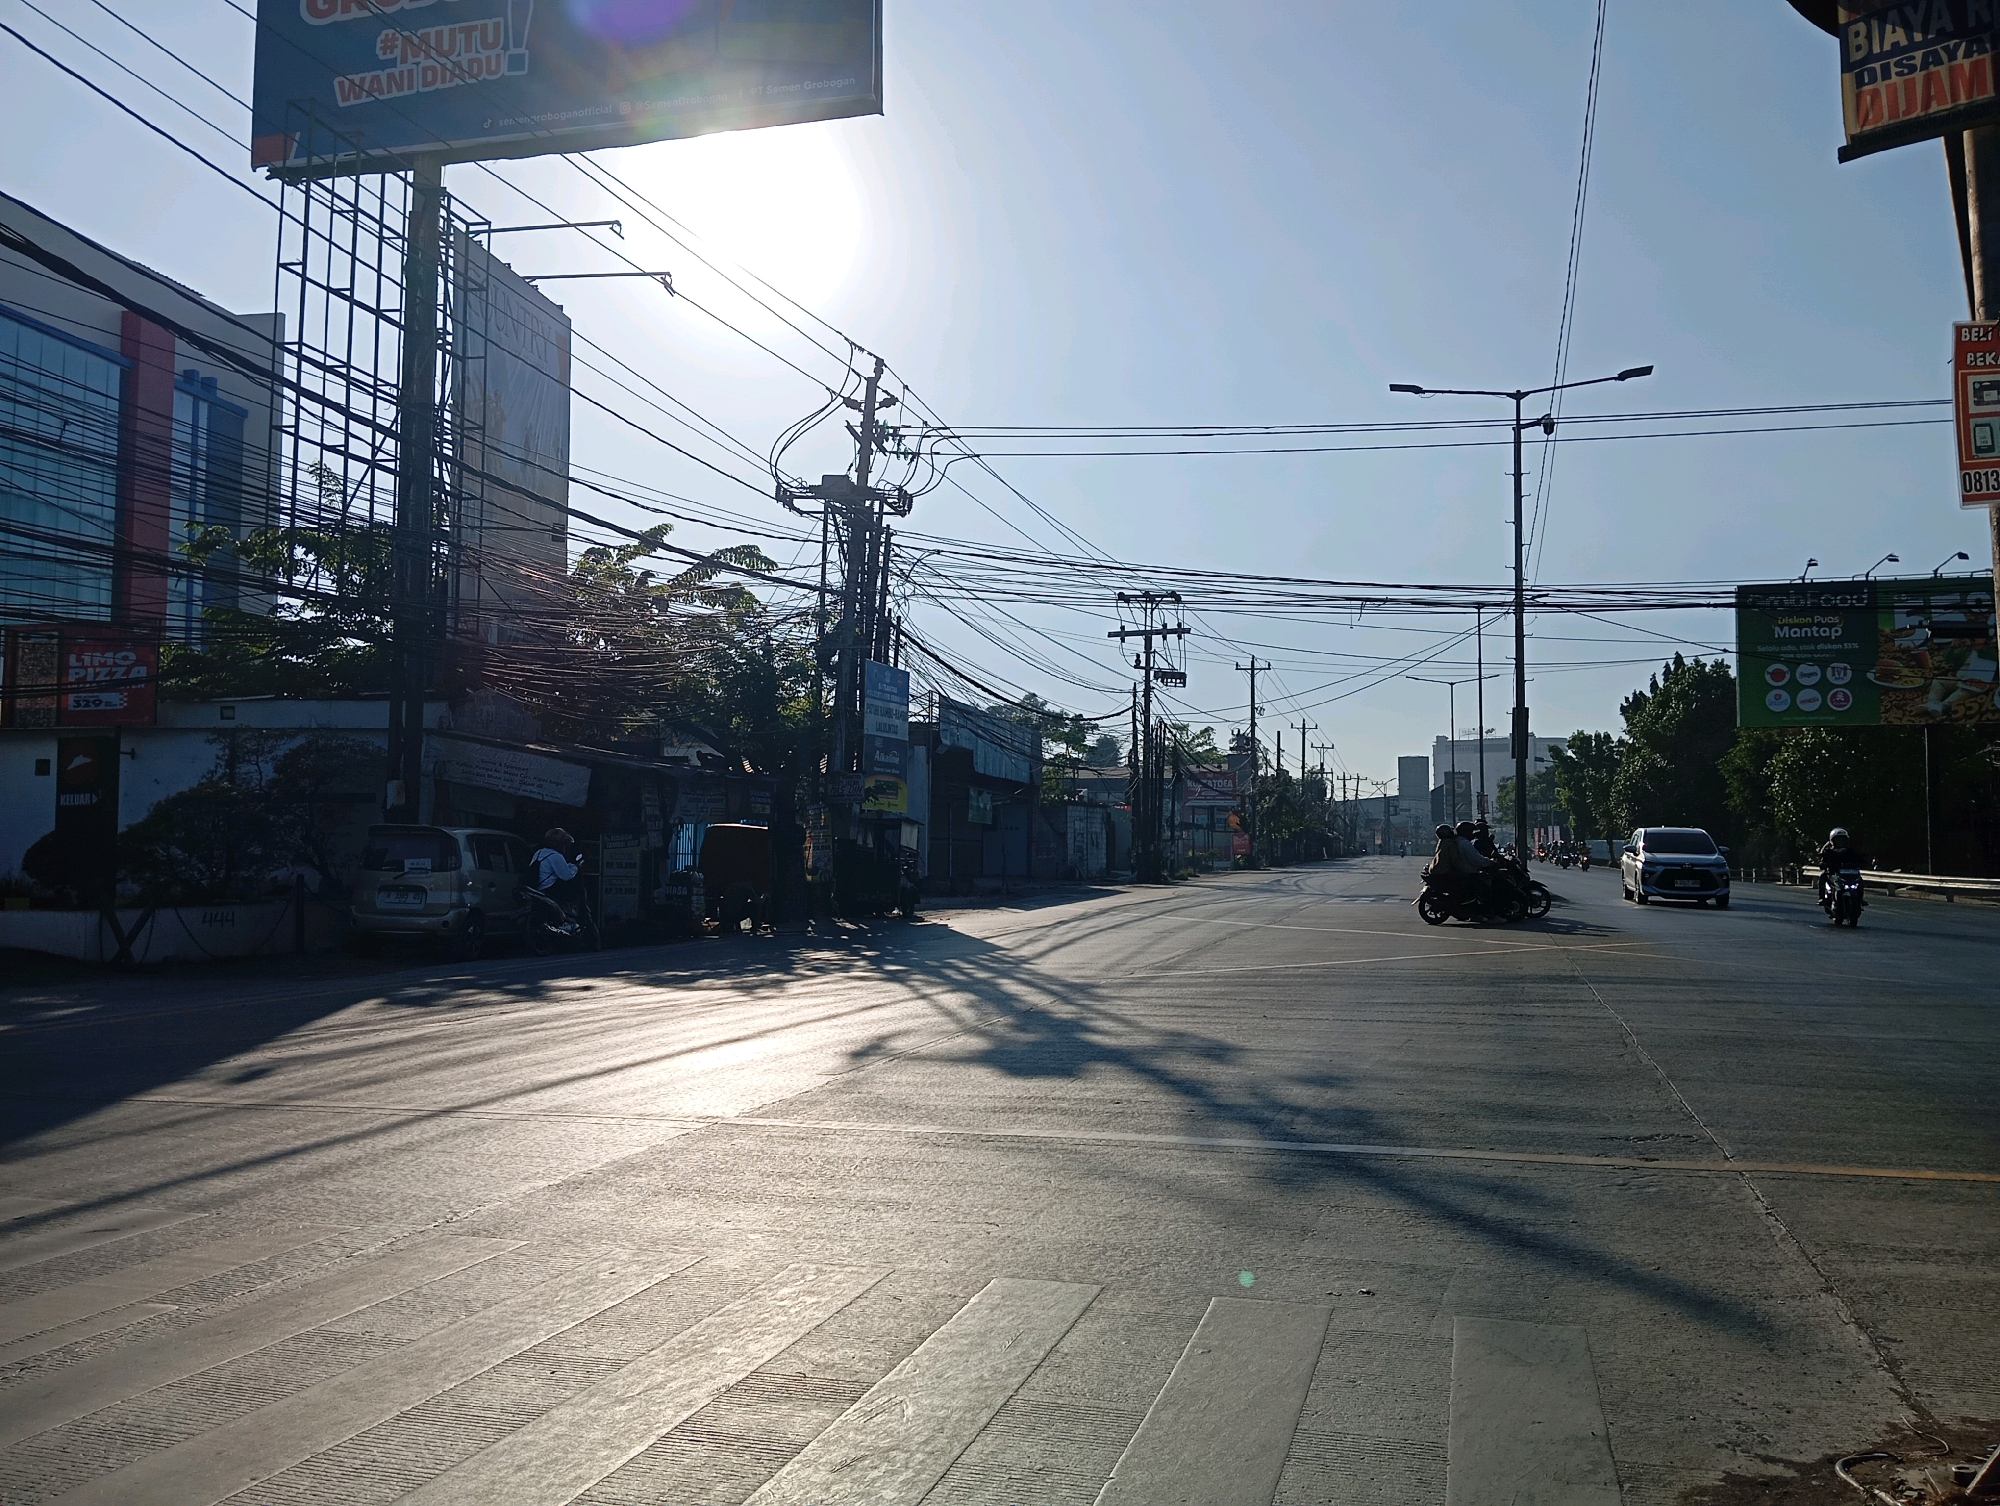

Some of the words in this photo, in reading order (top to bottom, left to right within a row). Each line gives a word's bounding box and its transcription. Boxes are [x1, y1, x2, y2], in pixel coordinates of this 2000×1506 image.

[1847, 0, 1955, 63] BIAYA
[378, 19, 503, 65] #MUTU
[1854, 35, 1990, 90] DISAYA
[337, 68, 415, 103] WANI
[750, 85, 763, 96] PT
[766, 83, 801, 95] Semen
[803, 77, 856, 91] Grobogan
[1855, 57, 1990, 129] DIJAM
[635, 93, 728, 112] @SemenGrobogan
[498, 103, 612, 128] semengroboganofficial
[465, 265, 552, 365] COUNTRY
[1961, 326, 1993, 342] BELI
[1963, 469, 2000, 494] 0813
[1777, 616, 1811, 625] Diskon
[1813, 614, 1840, 624] Puas
[1773, 625, 1843, 640] Mantap
[1816, 642, 1842, 651] diskon
[68, 665, 148, 682] PIZZA
[73, 699, 104, 709] 329
[549, 779, 565, 787] Angin
[60, 793, 91, 805] KELUAR
[202, 910, 235, 928] 444
